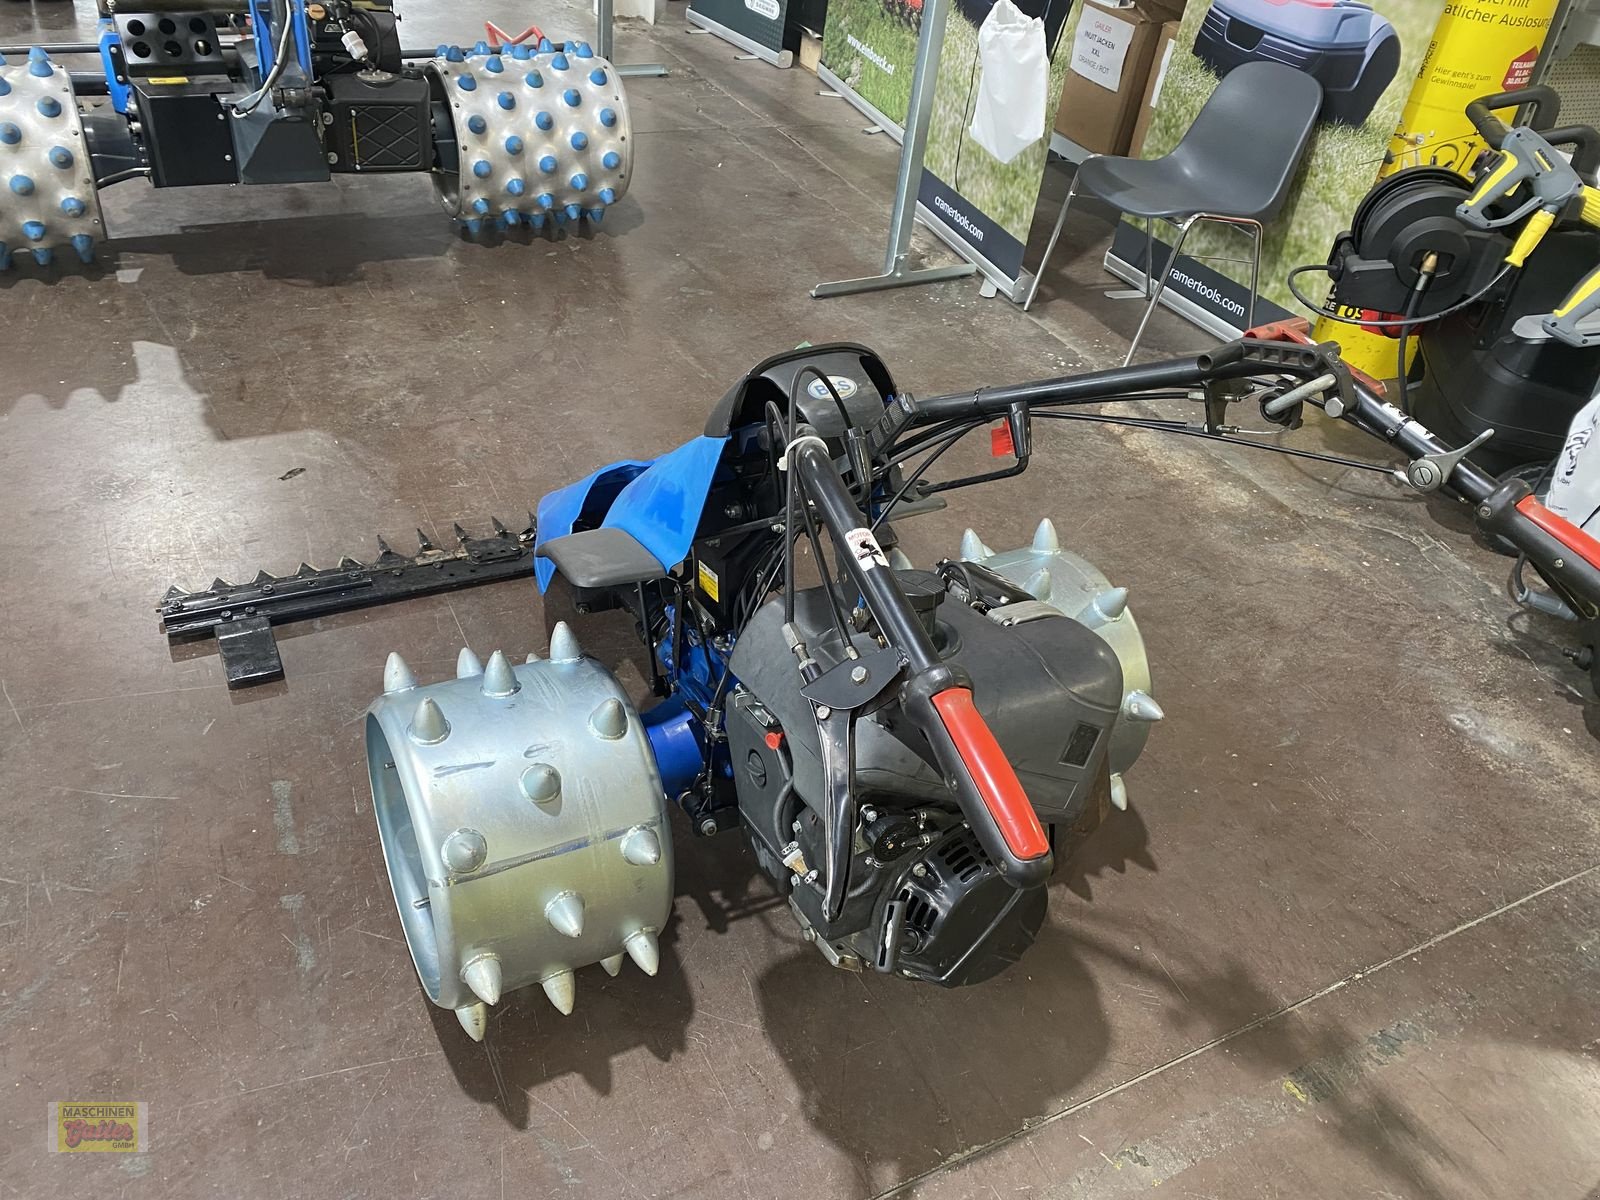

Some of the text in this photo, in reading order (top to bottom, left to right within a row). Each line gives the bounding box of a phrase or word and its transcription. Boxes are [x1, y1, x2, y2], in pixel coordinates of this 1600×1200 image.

[1444, 3, 1497, 24] atlicher
[1094, 20, 1112, 33] GAILER
[1091, 47, 1101, 58] XXL
[1434, 66, 1451, 76] Hier
[1475, 73, 1492, 81] zum
[1431, 75, 1477, 90] Gewinnspiel
[934, 195, 984, 242] cramertools.com
[1168, 267, 1245, 317] ramertools.com
[815, 380, 851, 396] BS
